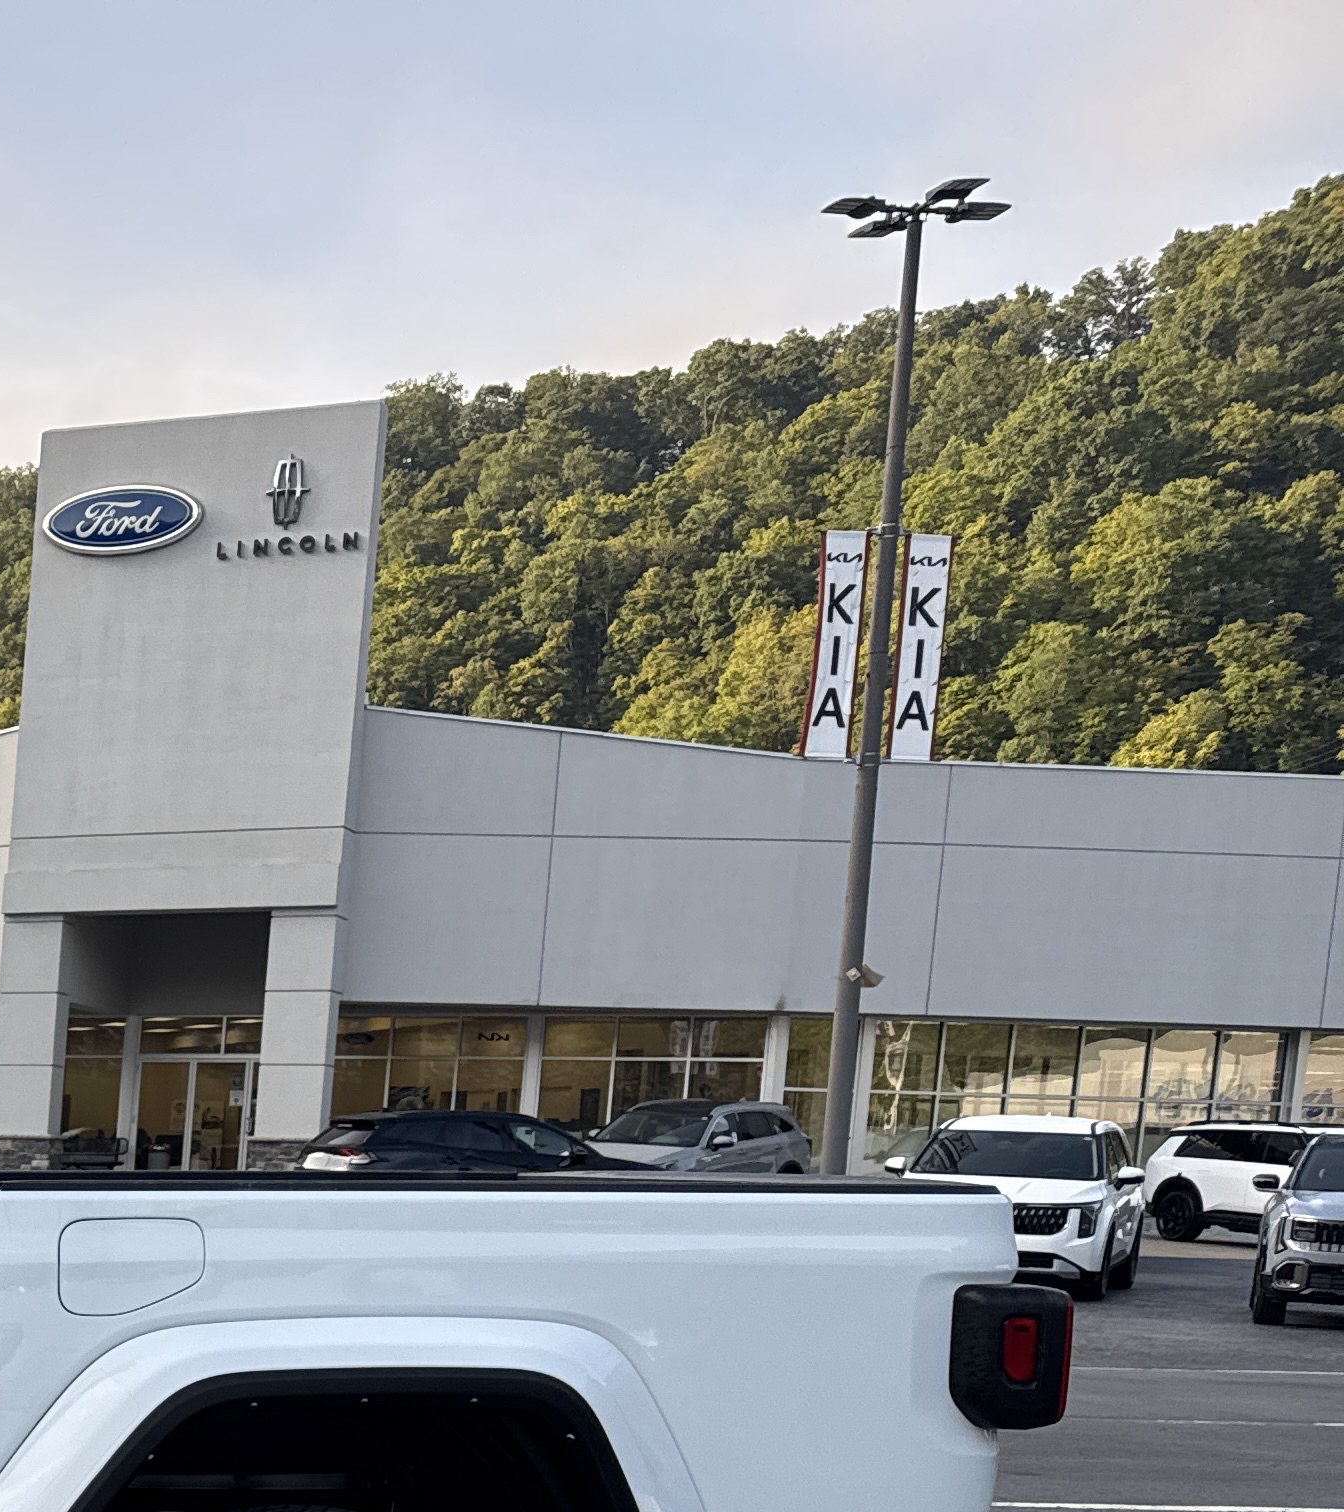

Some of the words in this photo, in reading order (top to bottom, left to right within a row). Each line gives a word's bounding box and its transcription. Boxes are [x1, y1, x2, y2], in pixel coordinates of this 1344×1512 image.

[74, 499, 164, 539] Ford
[217, 532, 360, 561] LINCOLN
[812, 583, 857, 728] KIA
[896, 586, 943, 731] KIA
